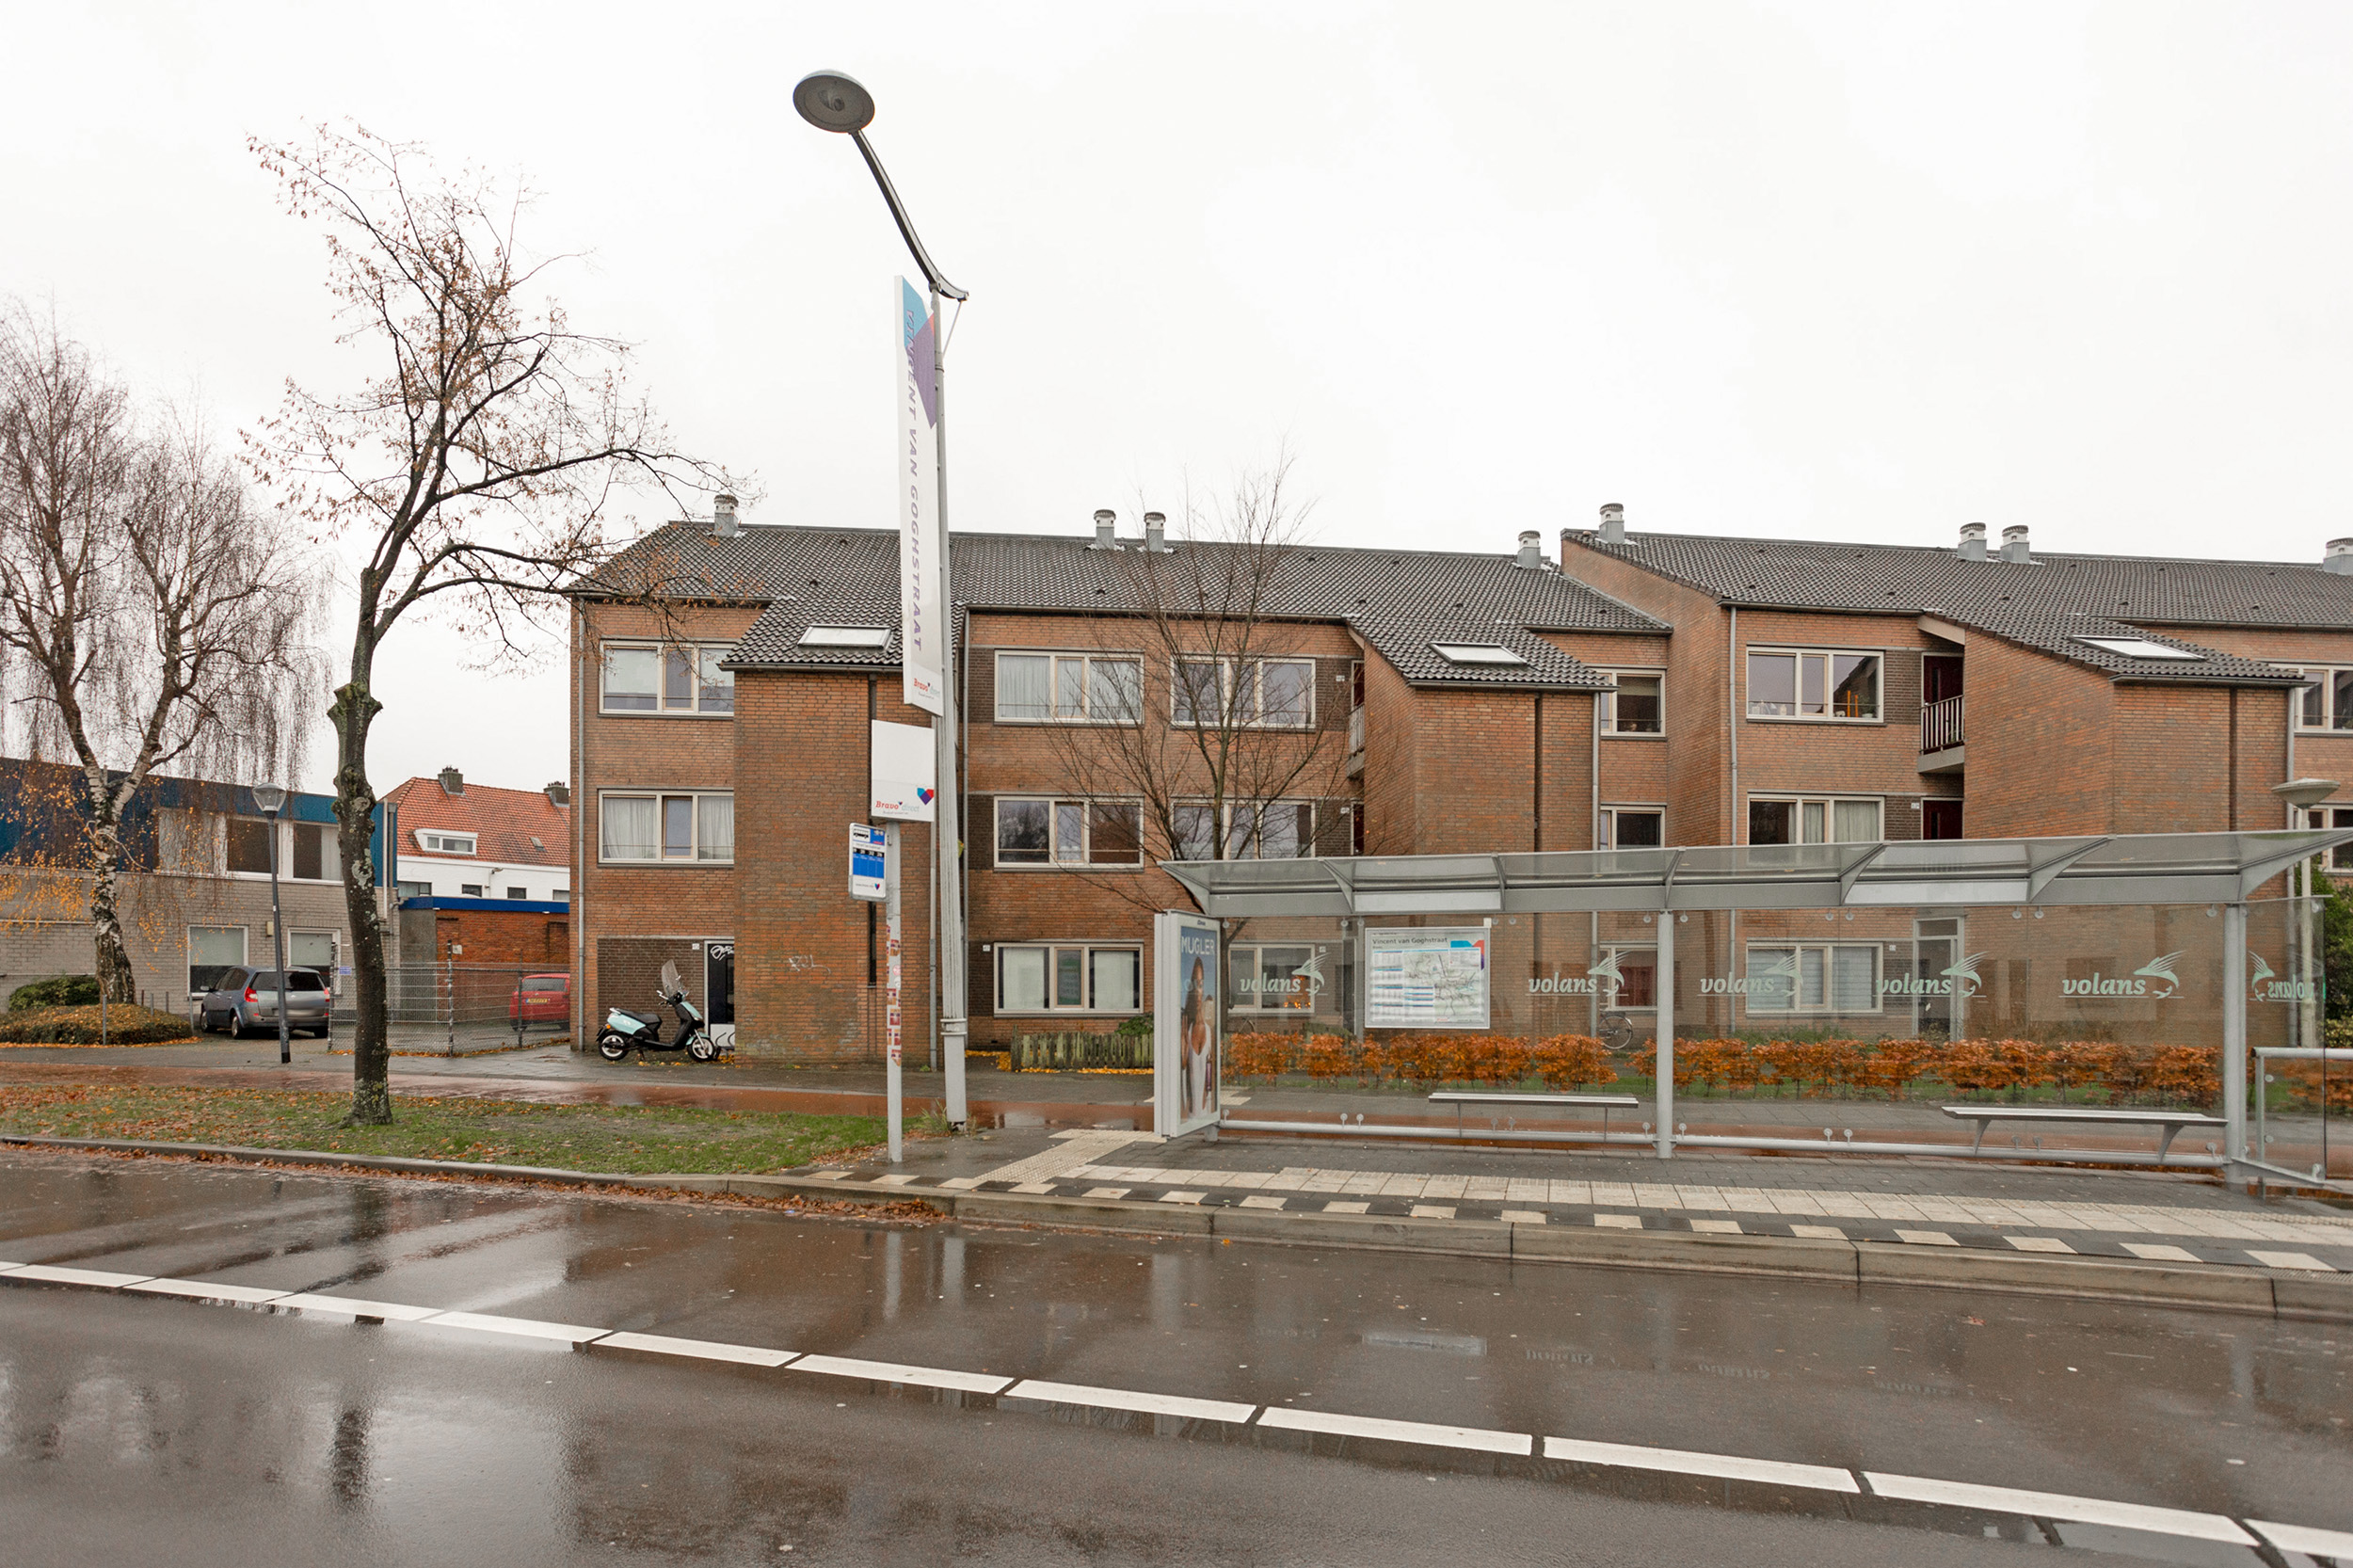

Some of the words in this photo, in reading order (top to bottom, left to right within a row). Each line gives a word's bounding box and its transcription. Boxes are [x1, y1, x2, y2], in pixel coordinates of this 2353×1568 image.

[906, 309, 916, 421] VINCENT
[909, 428, 918, 477] VAN
[910, 485, 921, 651] GOGHSTRAAT
[875, 800, 899, 809] Bravo
[1181, 936, 1215, 956] MUGLER
[1411, 936, 1448, 945] Goghstraat
[1240, 972, 1302, 993] volans
[1528, 971, 1598, 994] volans
[1700, 971, 1776, 994] volans
[1876, 972, 1952, 995] volans
[2062, 972, 2147, 996] volans
